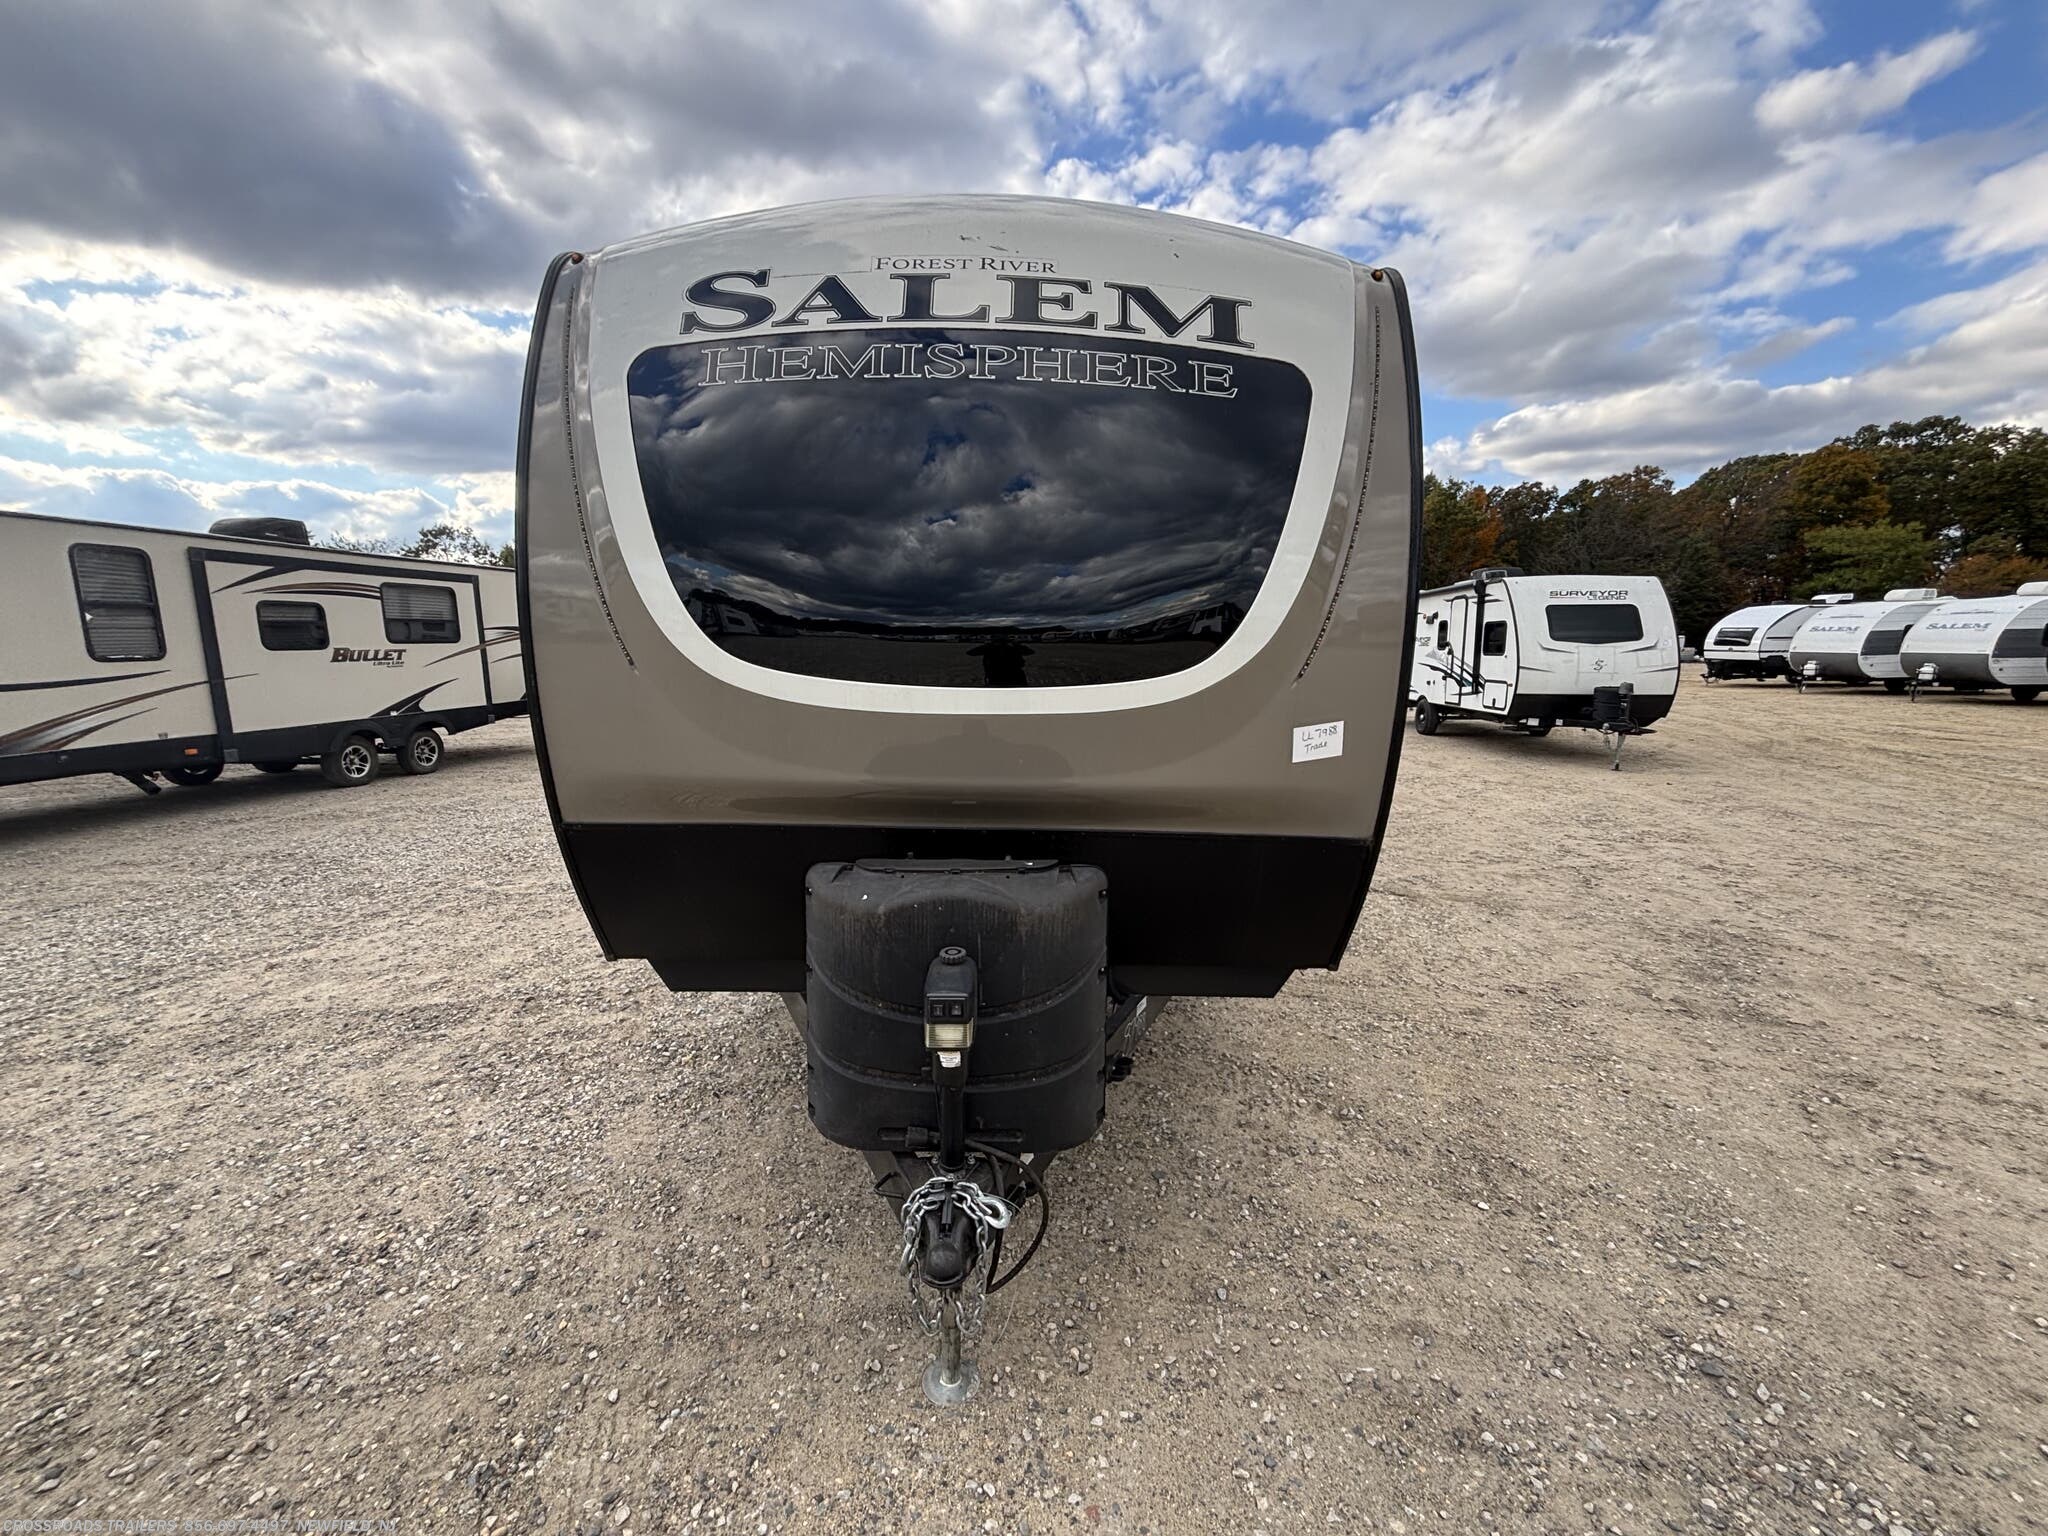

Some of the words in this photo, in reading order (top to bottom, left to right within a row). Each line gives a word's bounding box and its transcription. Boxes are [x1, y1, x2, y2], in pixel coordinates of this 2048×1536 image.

[876, 257, 973, 271] FOREST
[979, 257, 1056, 274] RIVER
[680, 268, 1256, 351] SALEM
[698, 342, 1239, 399] HEMISPHERE
[1809, 625, 1860, 633] SALEM
[1926, 622, 1992, 630] SALEM
[330, 647, 407, 663] BULLET
[1304, 741, 1327, 754] Trade
